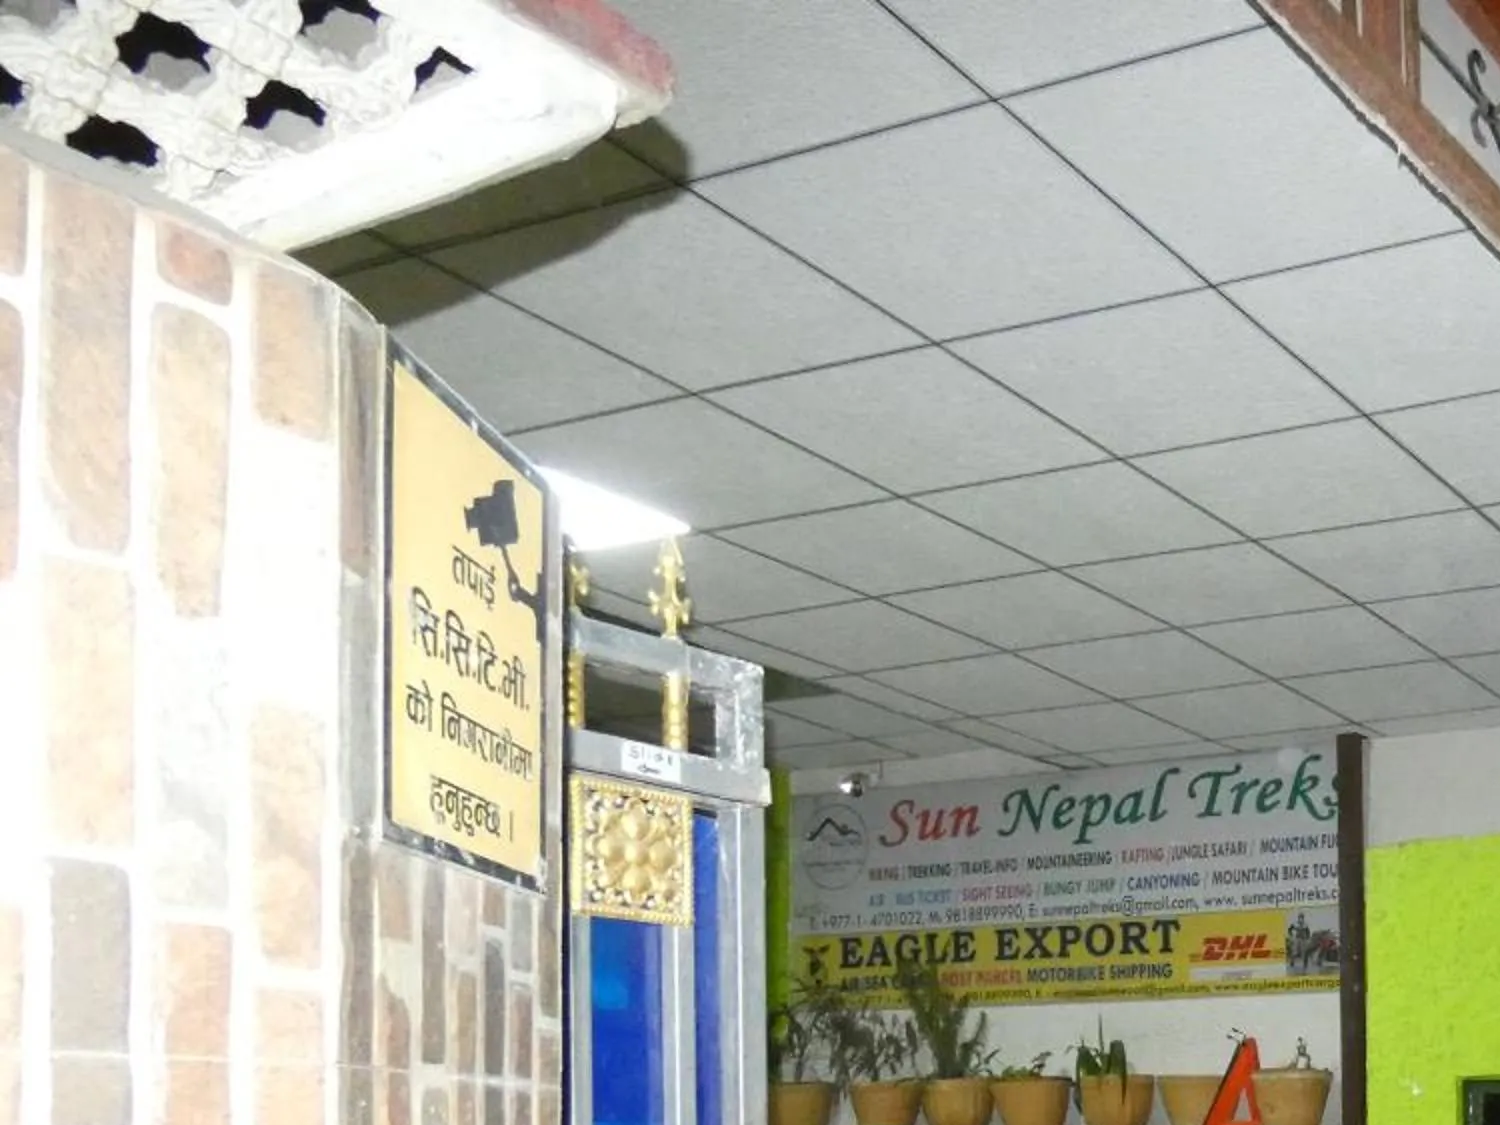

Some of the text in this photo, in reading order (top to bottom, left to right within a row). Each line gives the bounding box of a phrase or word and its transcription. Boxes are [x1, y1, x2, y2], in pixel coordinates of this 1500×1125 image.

[405, 680, 434, 732] को
[879, 799, 981, 848] Sun
[997, 767, 1180, 844] Nepal
[1261, 834, 1318, 853] MOUNTAIN
[1127, 872, 1200, 892] CANYONING
[1212, 867, 1279, 885] MOUNTAIN
[1282, 865, 1308, 880] BIKE
[840, 920, 1181, 968] EAGLE EXPORT
[1202, 933, 1270, 962] DHL
[1027, 965, 1104, 983] MOTORBIKE
[1110, 963, 1174, 981] SHIPPING
